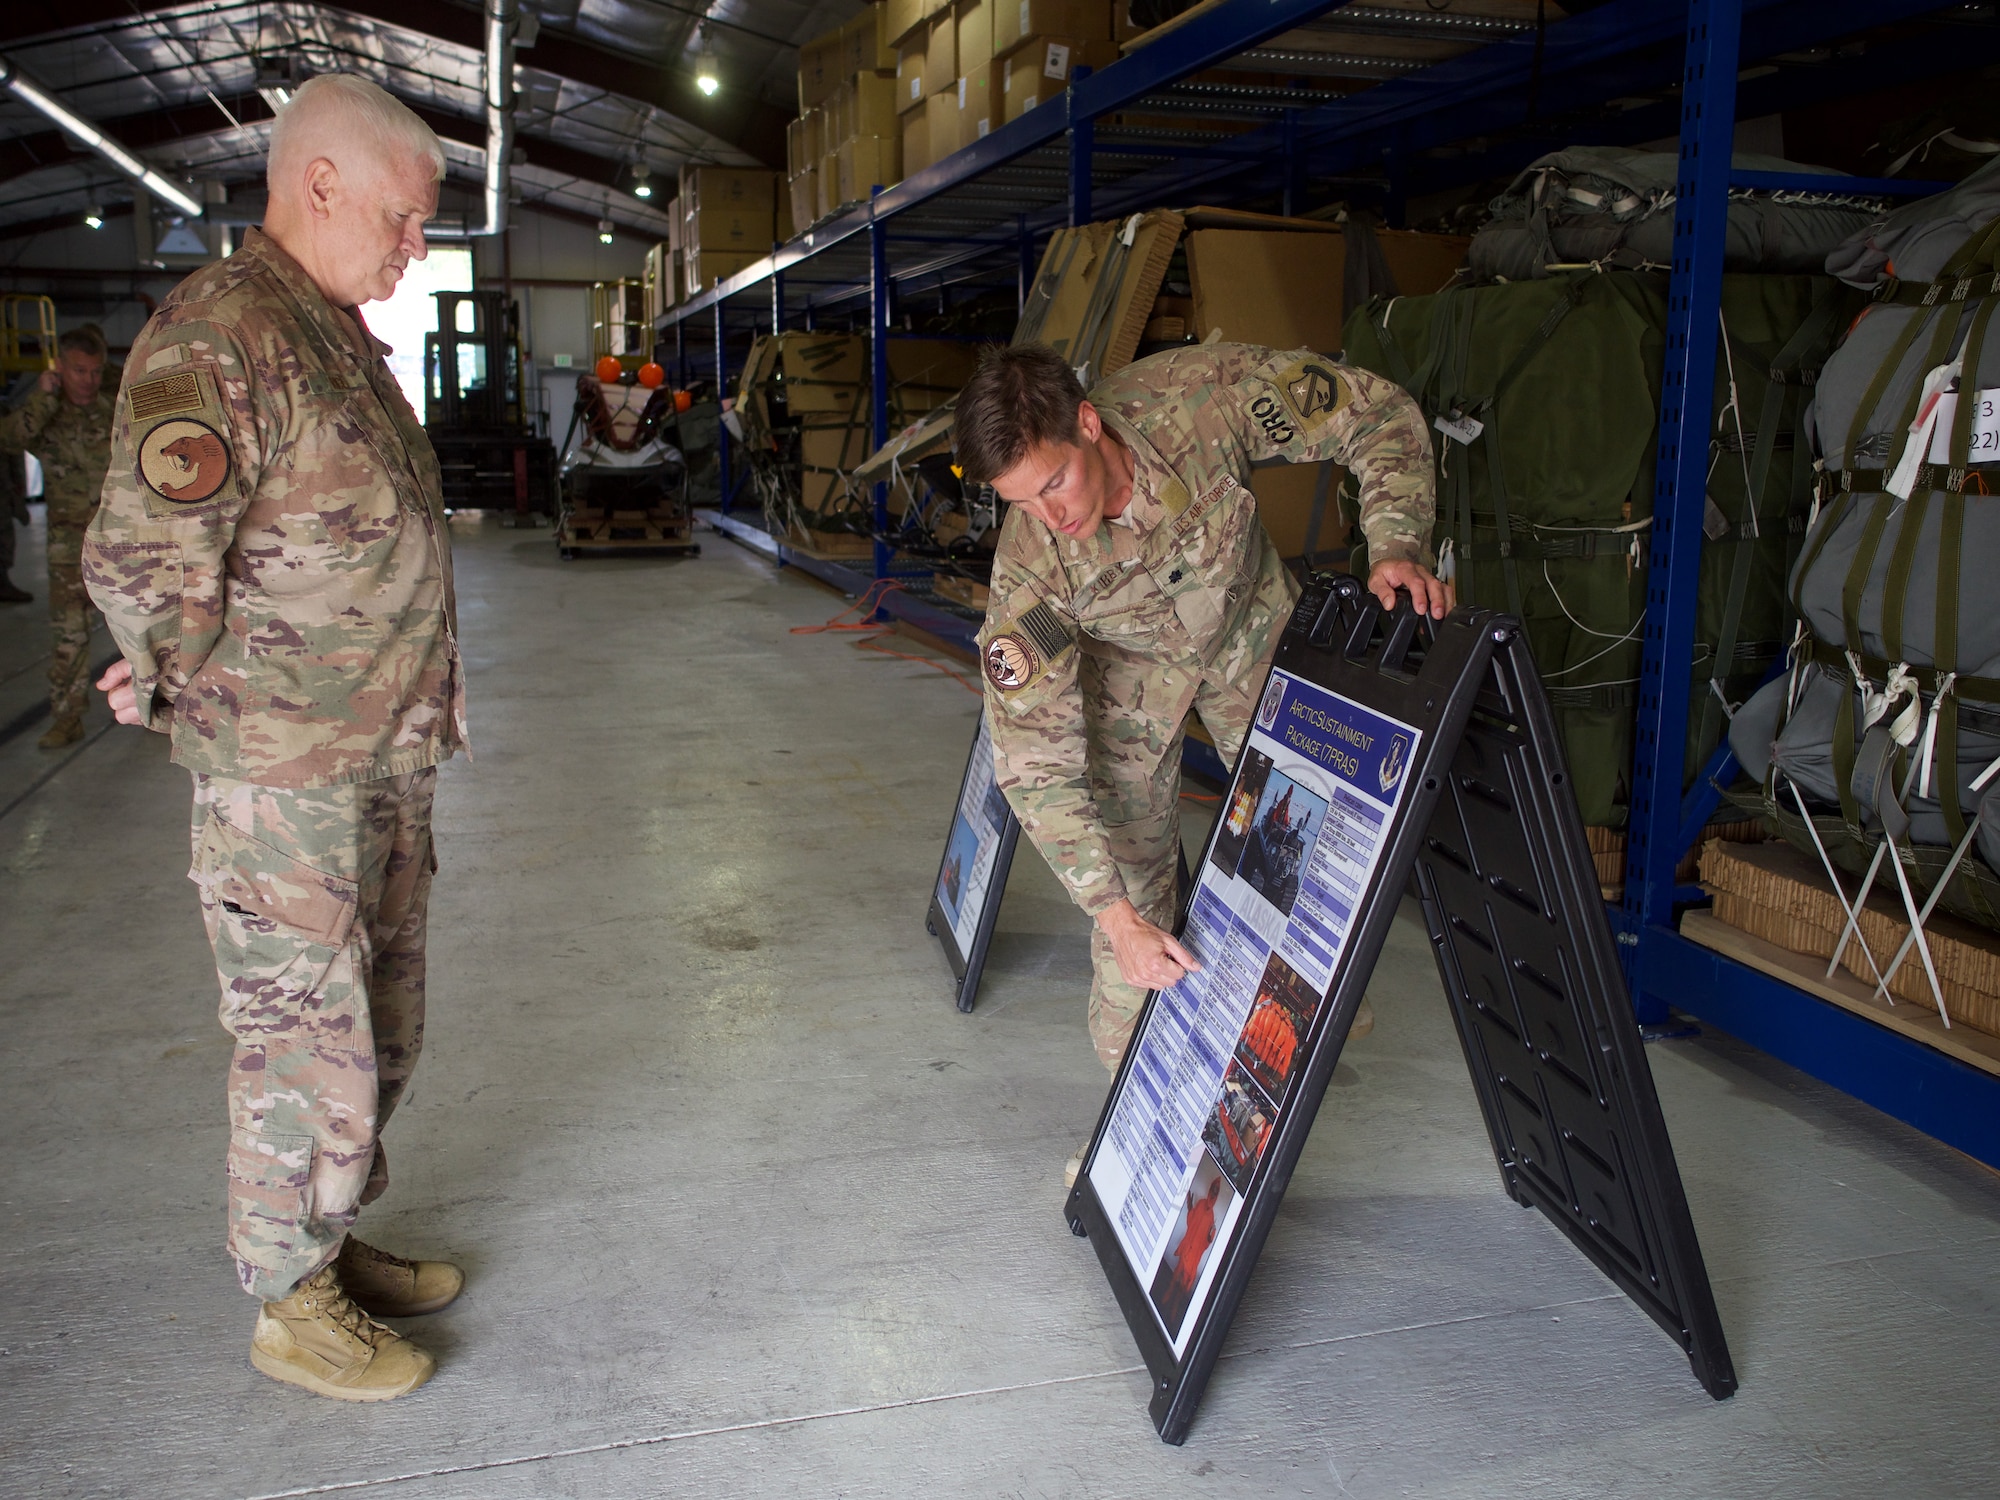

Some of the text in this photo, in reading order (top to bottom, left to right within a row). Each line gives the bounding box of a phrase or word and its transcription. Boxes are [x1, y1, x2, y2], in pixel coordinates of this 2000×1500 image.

[1252, 397, 1294, 443] CRO
[1189, 503, 1206, 522] AIR
[1203, 475, 1236, 507] FORCE
[1090, 562, 1125, 594] KIRBY
[1285, 725, 1360, 778] PACKAGE (7PRAS)
